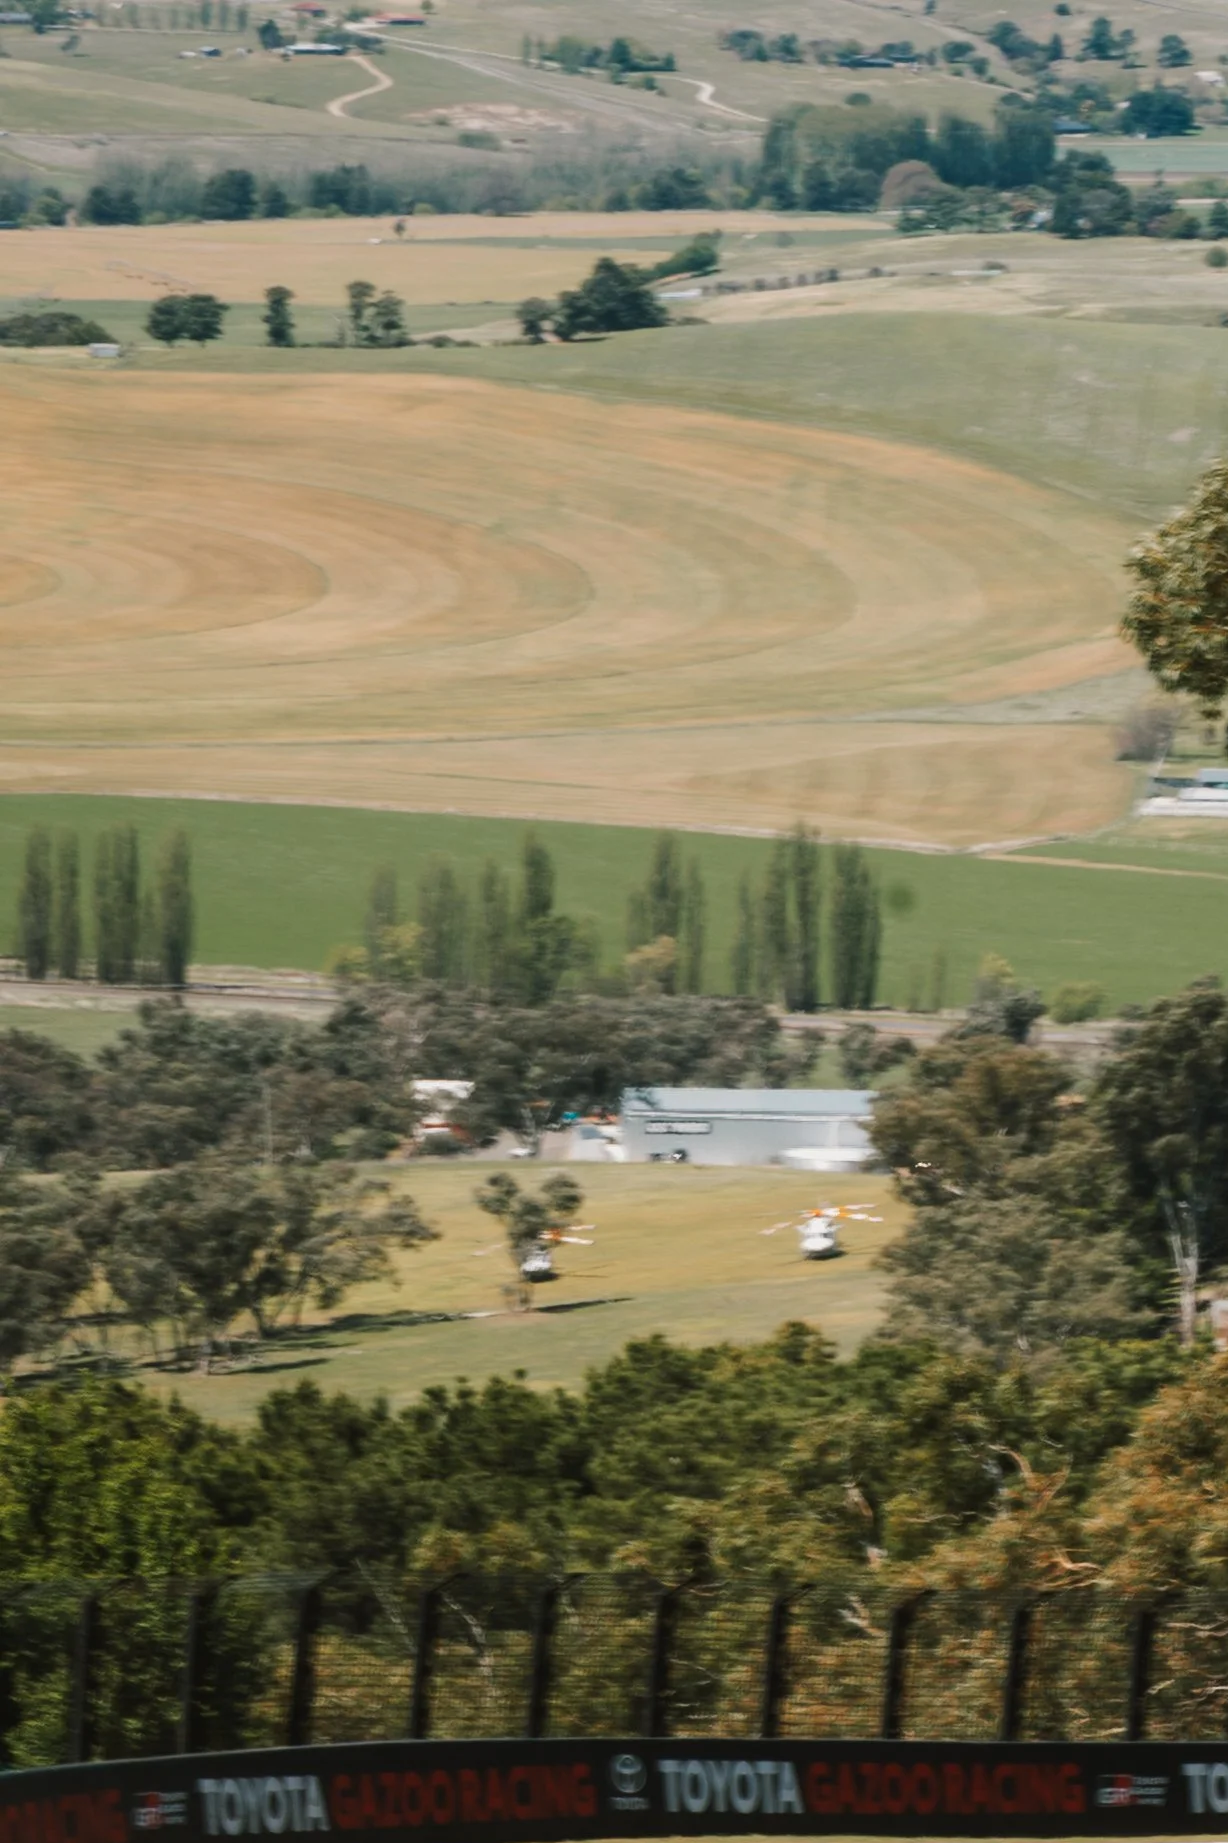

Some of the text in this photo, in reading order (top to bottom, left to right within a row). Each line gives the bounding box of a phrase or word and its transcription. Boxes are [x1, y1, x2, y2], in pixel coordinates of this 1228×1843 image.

[196, 1776, 331, 1835] TOYOTA
[330, 1769, 456, 1829] GAZOO
[458, 1763, 597, 1822] RACING
[657, 1760, 804, 1813] TOYOTA
[808, 1762, 939, 1814] GAZOO
[941, 1762, 1087, 1814] RACING
